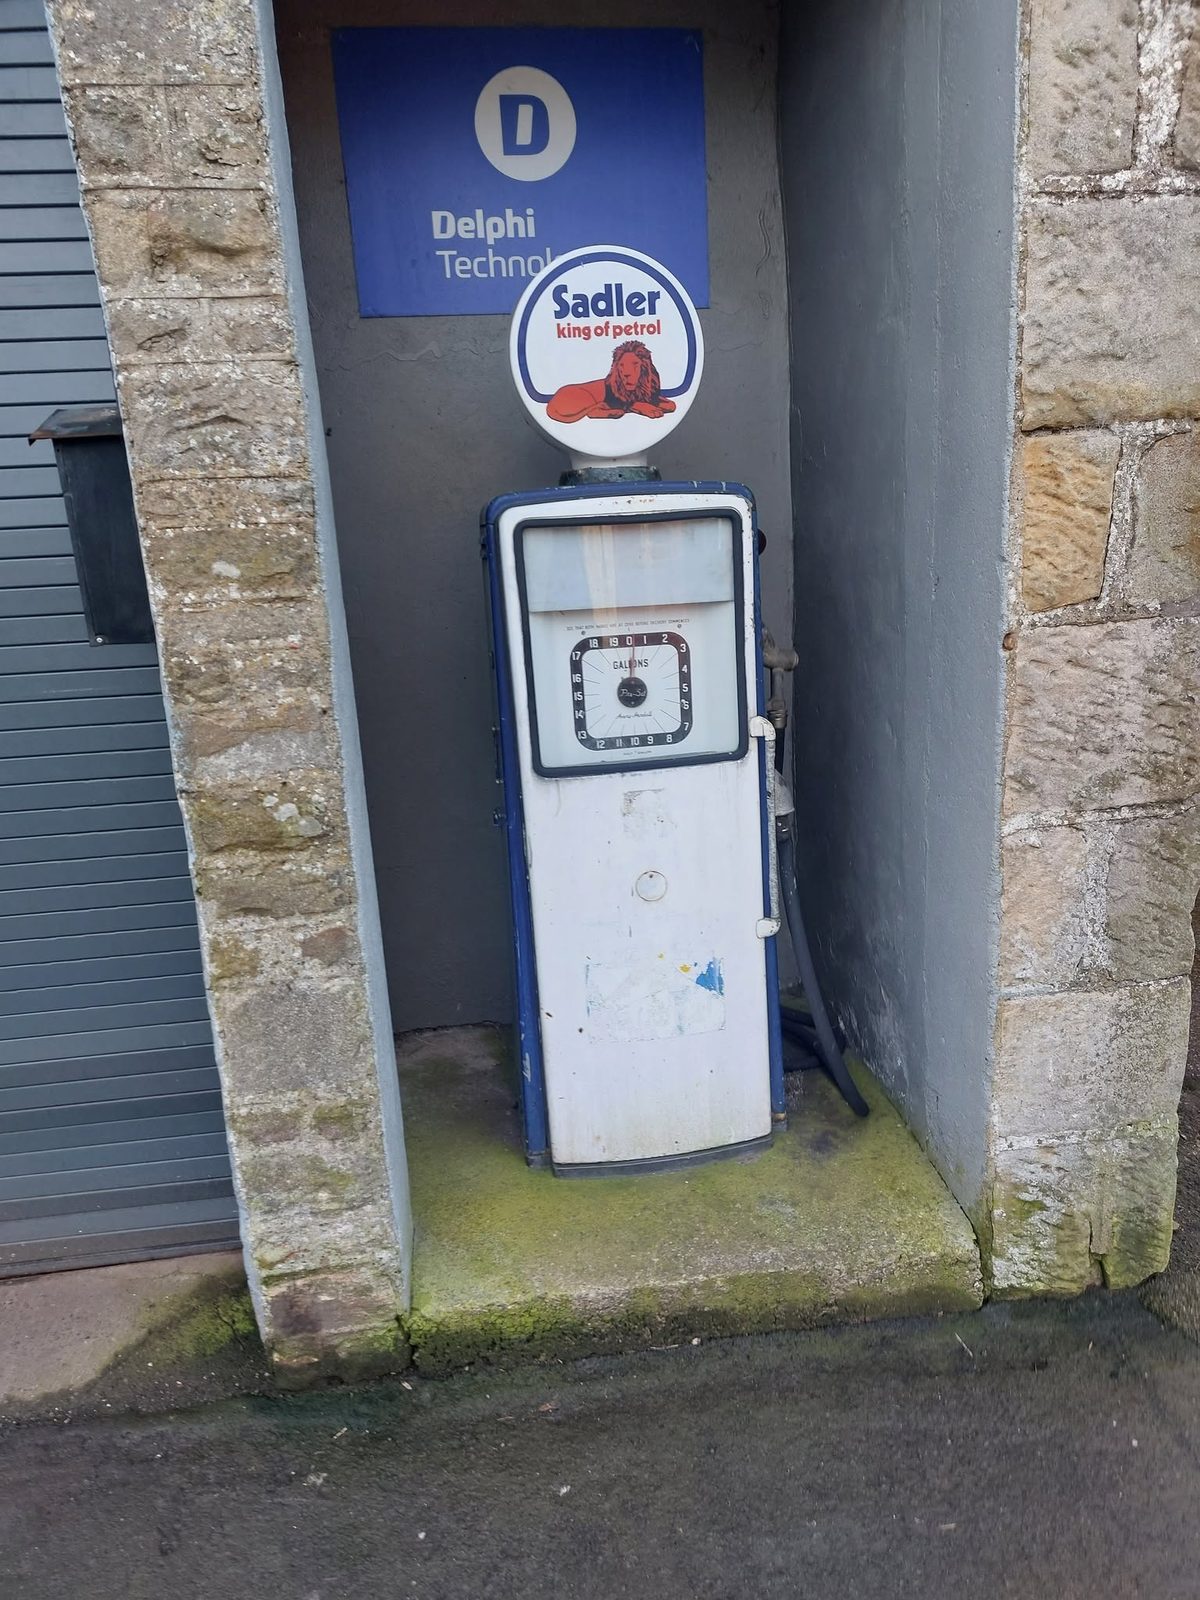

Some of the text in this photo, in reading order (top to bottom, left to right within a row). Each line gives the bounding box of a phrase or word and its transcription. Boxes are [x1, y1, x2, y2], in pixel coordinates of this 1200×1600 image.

[499, 94, 550, 156] D
[431, 207, 536, 245] Delphi
[435, 247, 560, 279] Technol
[552, 283, 661, 319] Sadler
[556, 319, 661, 341] king of petrol
[589, 638, 599, 648] 18
[609, 637, 619, 647] 19
[626, 636, 633, 645] 0
[662, 634, 669, 643] 2
[680, 643, 687, 653] 3
[571, 651, 581, 661] 17
[681, 664, 688, 674] 4
[572, 673, 582, 683] 16
[682, 683, 689, 693] 5
[573, 691, 583, 701] 15
[575, 710, 585, 719] 14
[683, 722, 690, 731] 7
[577, 731, 587, 740] 13
[647, 735, 654, 745] 9
[666, 734, 673, 743] 8
[596, 739, 606, 749] 12
[630, 737, 640, 746] 10
